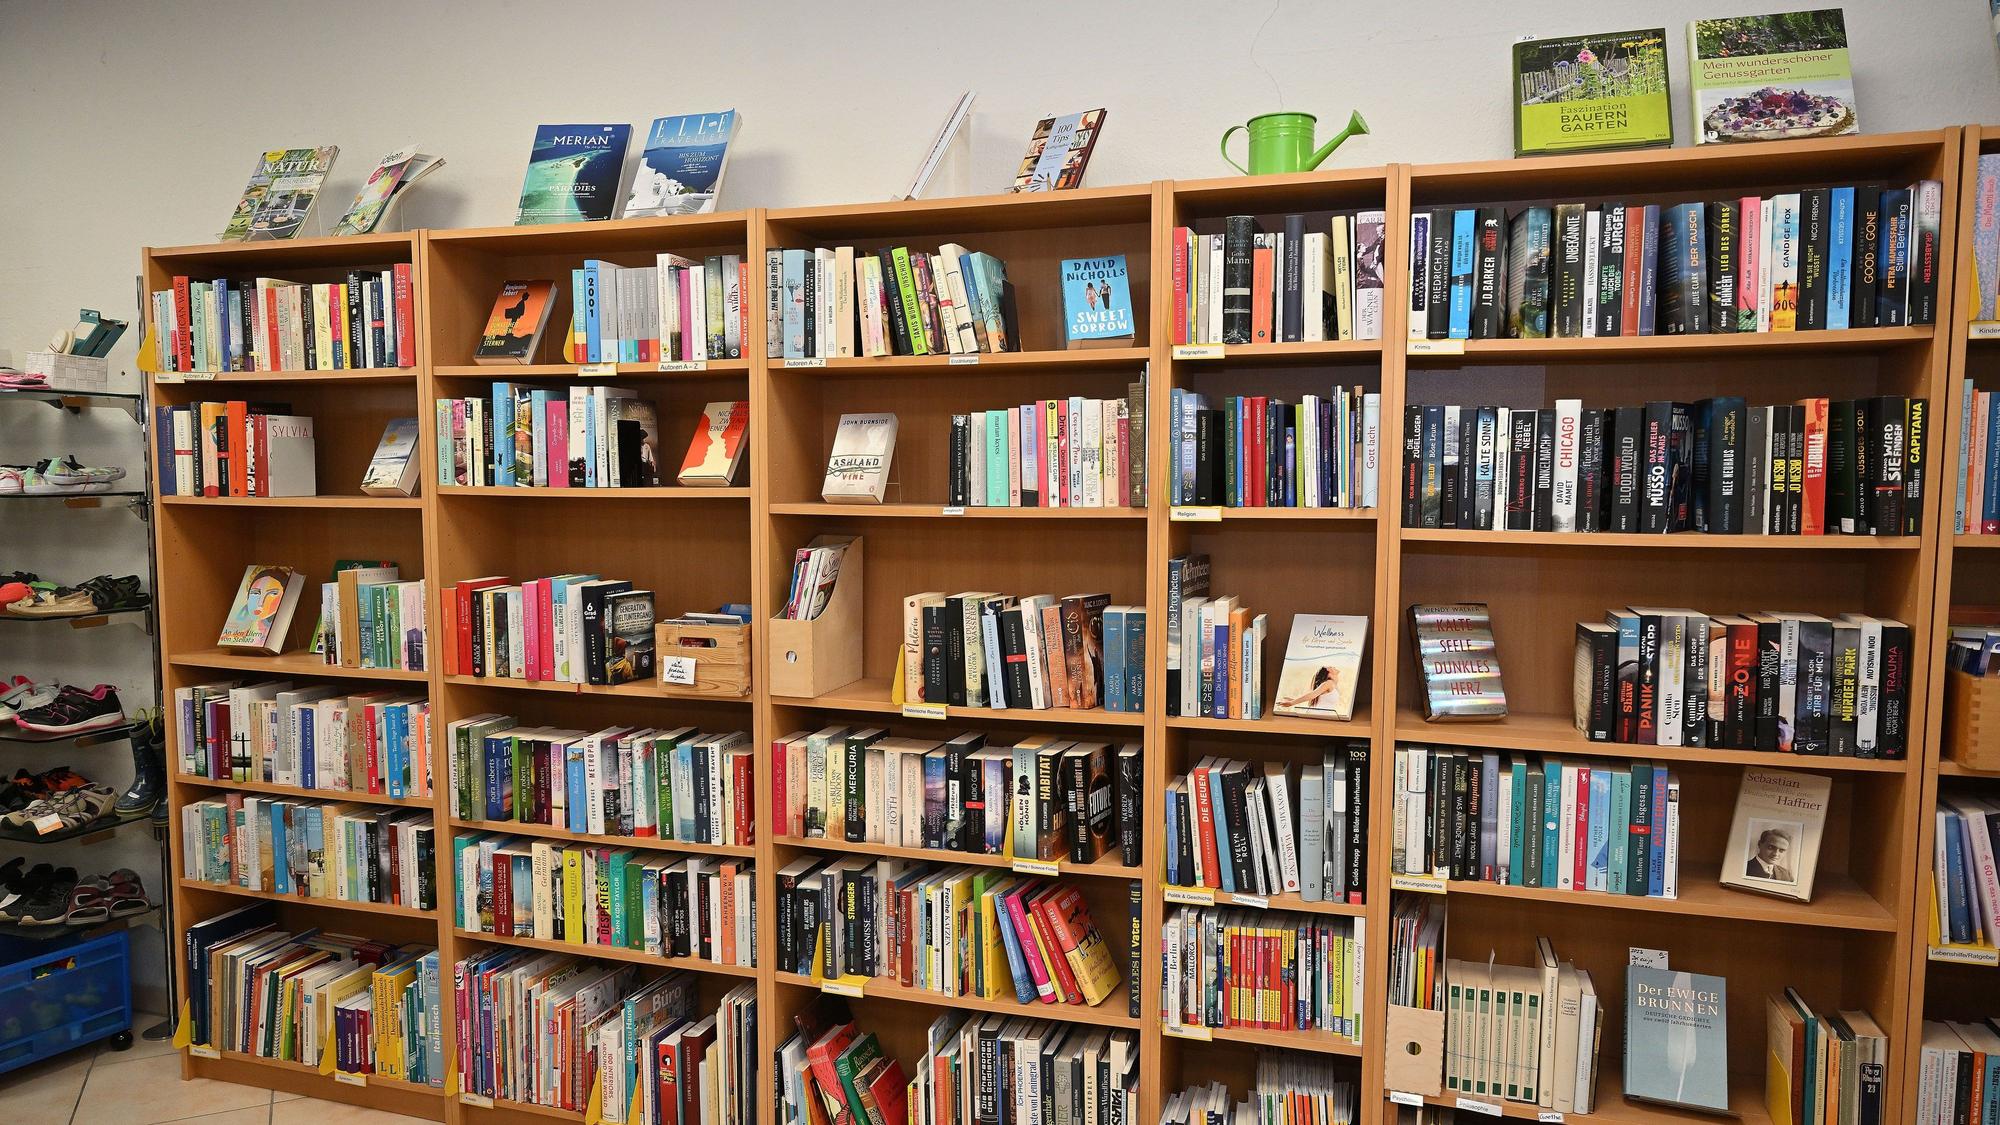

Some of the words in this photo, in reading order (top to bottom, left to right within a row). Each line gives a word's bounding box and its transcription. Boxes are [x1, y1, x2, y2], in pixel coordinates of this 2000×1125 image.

[1703, 62, 1732, 70] Mein
[1737, 53, 1832, 67] wunderschöner
[1704, 67, 1790, 79] Genussgarten
[1560, 103, 1626, 114] Faszination
[1561, 111, 1627, 123] BAUERN
[657, 114, 728, 137] ELLE
[1057, 124, 1073, 133] 100
[1562, 120, 1627, 132] GARTEN
[553, 136, 609, 145] MERIAN
[1053, 134, 1069, 143] Tips
[1604, 215, 1613, 247] Wolfgang
[1613, 207, 1624, 253] BURGER
[1722, 207, 1730, 232] ZORNS
[1866, 211, 1876, 240] GONE
[1897, 205, 1908, 248] Befreiung
[1566, 216, 1580, 262] UNBEKANNTE
[1721, 237, 1729, 251] DES
[1889, 217, 1897, 264] HAMMESFAHR
[1074, 260, 1115, 271] DAVID
[1721, 254, 1729, 271] LIED
[1864, 253, 1874, 283] GOOD
[1896, 251, 1904, 271] Stille
[1924, 232, 1932, 283] GRABESSTERN
[1067, 268, 1125, 281] NICHOLLS
[1433, 258, 1442, 303] FRIEDRICH
[177, 282, 185, 303] WAR
[587, 278, 595, 318] 2001
[1072, 321, 1127, 334] SORROW
[1078, 309, 1126, 323] SWEET
[178, 305, 187, 358] AMERICAN
[272, 426, 308, 438] SYLVIA
[1367, 426, 1376, 446] lacht
[1413, 415, 1421, 458] ZÜGELLOSEN
[1482, 418, 1491, 446] SONNE
[1515, 420, 1523, 451] FINSTER
[1523, 423, 1531, 449] NEBEL
[1560, 417, 1574, 468] CHICAGO
[1650, 422, 1658, 447] ATELIER
[1884, 424, 1893, 456] WIRD
[1894, 424, 1902, 456] FINDEN
[1910, 403, 1922, 463] CAPITANA
[1366, 449, 1376, 469] Gott
[1481, 448, 1490, 475] KALTE
[1622, 437, 1633, 471] WORLD
[1723, 450, 1734, 477] NEUHAUS
[1774, 459, 1785, 482] NESBØ
[1790, 460, 1802, 482] NESBØ
[1889, 458, 1901, 480] SIE
[1564, 480, 1572, 505] MAMET
[1620, 474, 1632, 504] BLOOD
[1651, 466, 1664, 506] MUSSO
[1722, 481, 1733, 495] NELE
[1774, 484, 1785, 492] JO
[1790, 484, 1801, 493] JO
[1169, 571, 1179, 612] Propheten
[587, 603, 593, 611] 6
[615, 612, 652, 622] WELTUNTERGANG
[619, 604, 647, 614] GENERATION
[1168, 614, 1178, 628] Die
[1204, 618, 1212, 640] MEHR
[1314, 625, 1344, 637] Wellness
[1436, 619, 1472, 631] KALTE
[905, 617, 919, 653] Malerin
[1440, 639, 1472, 652] SEELE
[1646, 624, 1656, 659] STARR
[1434, 660, 1490, 674] DUNKLES
[1733, 639, 1750, 697] ZONE
[1816, 651, 1824, 672] MICH
[1844, 648, 1856, 673] PARK
[1886, 646, 1898, 694] TRAUMA
[1451, 682, 1482, 695] HERZ
[1842, 675, 1854, 722] MURDER
[904, 707, 926, 715] Historische
[1640, 684, 1654, 729] PANIK
[1664, 693, 1672, 725] Camilla
[1688, 695, 1696, 727] Camilla
[1813, 695, 1821, 717] STIRB
[587, 740, 595, 778] METROPOL
[849, 745, 857, 794] MERCURIA
[1040, 756, 1051, 800] HABITAT
[1747, 772, 1800, 789] Sebastian
[1637, 784, 1647, 824] Eisgesang
[1776, 795, 1822, 811] Haffner
[1202, 810, 1210, 823] DIE
[1234, 833, 1242, 863] EVELYN
[1395, 879, 1442, 889] Erfahrungsberichte
[600, 881, 609, 935] DESPENTES
[847, 882, 855, 920] STRANGERS
[1186, 894, 1212, 902] Geschichte
[1131, 917, 1141, 948] Vater
[1169, 943, 1178, 970] Berlin
[1931, 949, 1997, 961] Lebenshilfe/Ratgeber
[1131, 962, 1139, 1003] ALLES
[1638, 983, 1662, 994] Der
[1667, 987, 1719, 1003] EWIGE
[652, 986, 682, 1012] Büro
[1638, 997, 1719, 1016] BRUNNEN
[432, 1005, 440, 1053] Italienisch
[627, 1034, 633, 1042] zu
[1027, 1062, 1037, 1097] Leningrad
[1029, 1098, 1038, 1111] von
